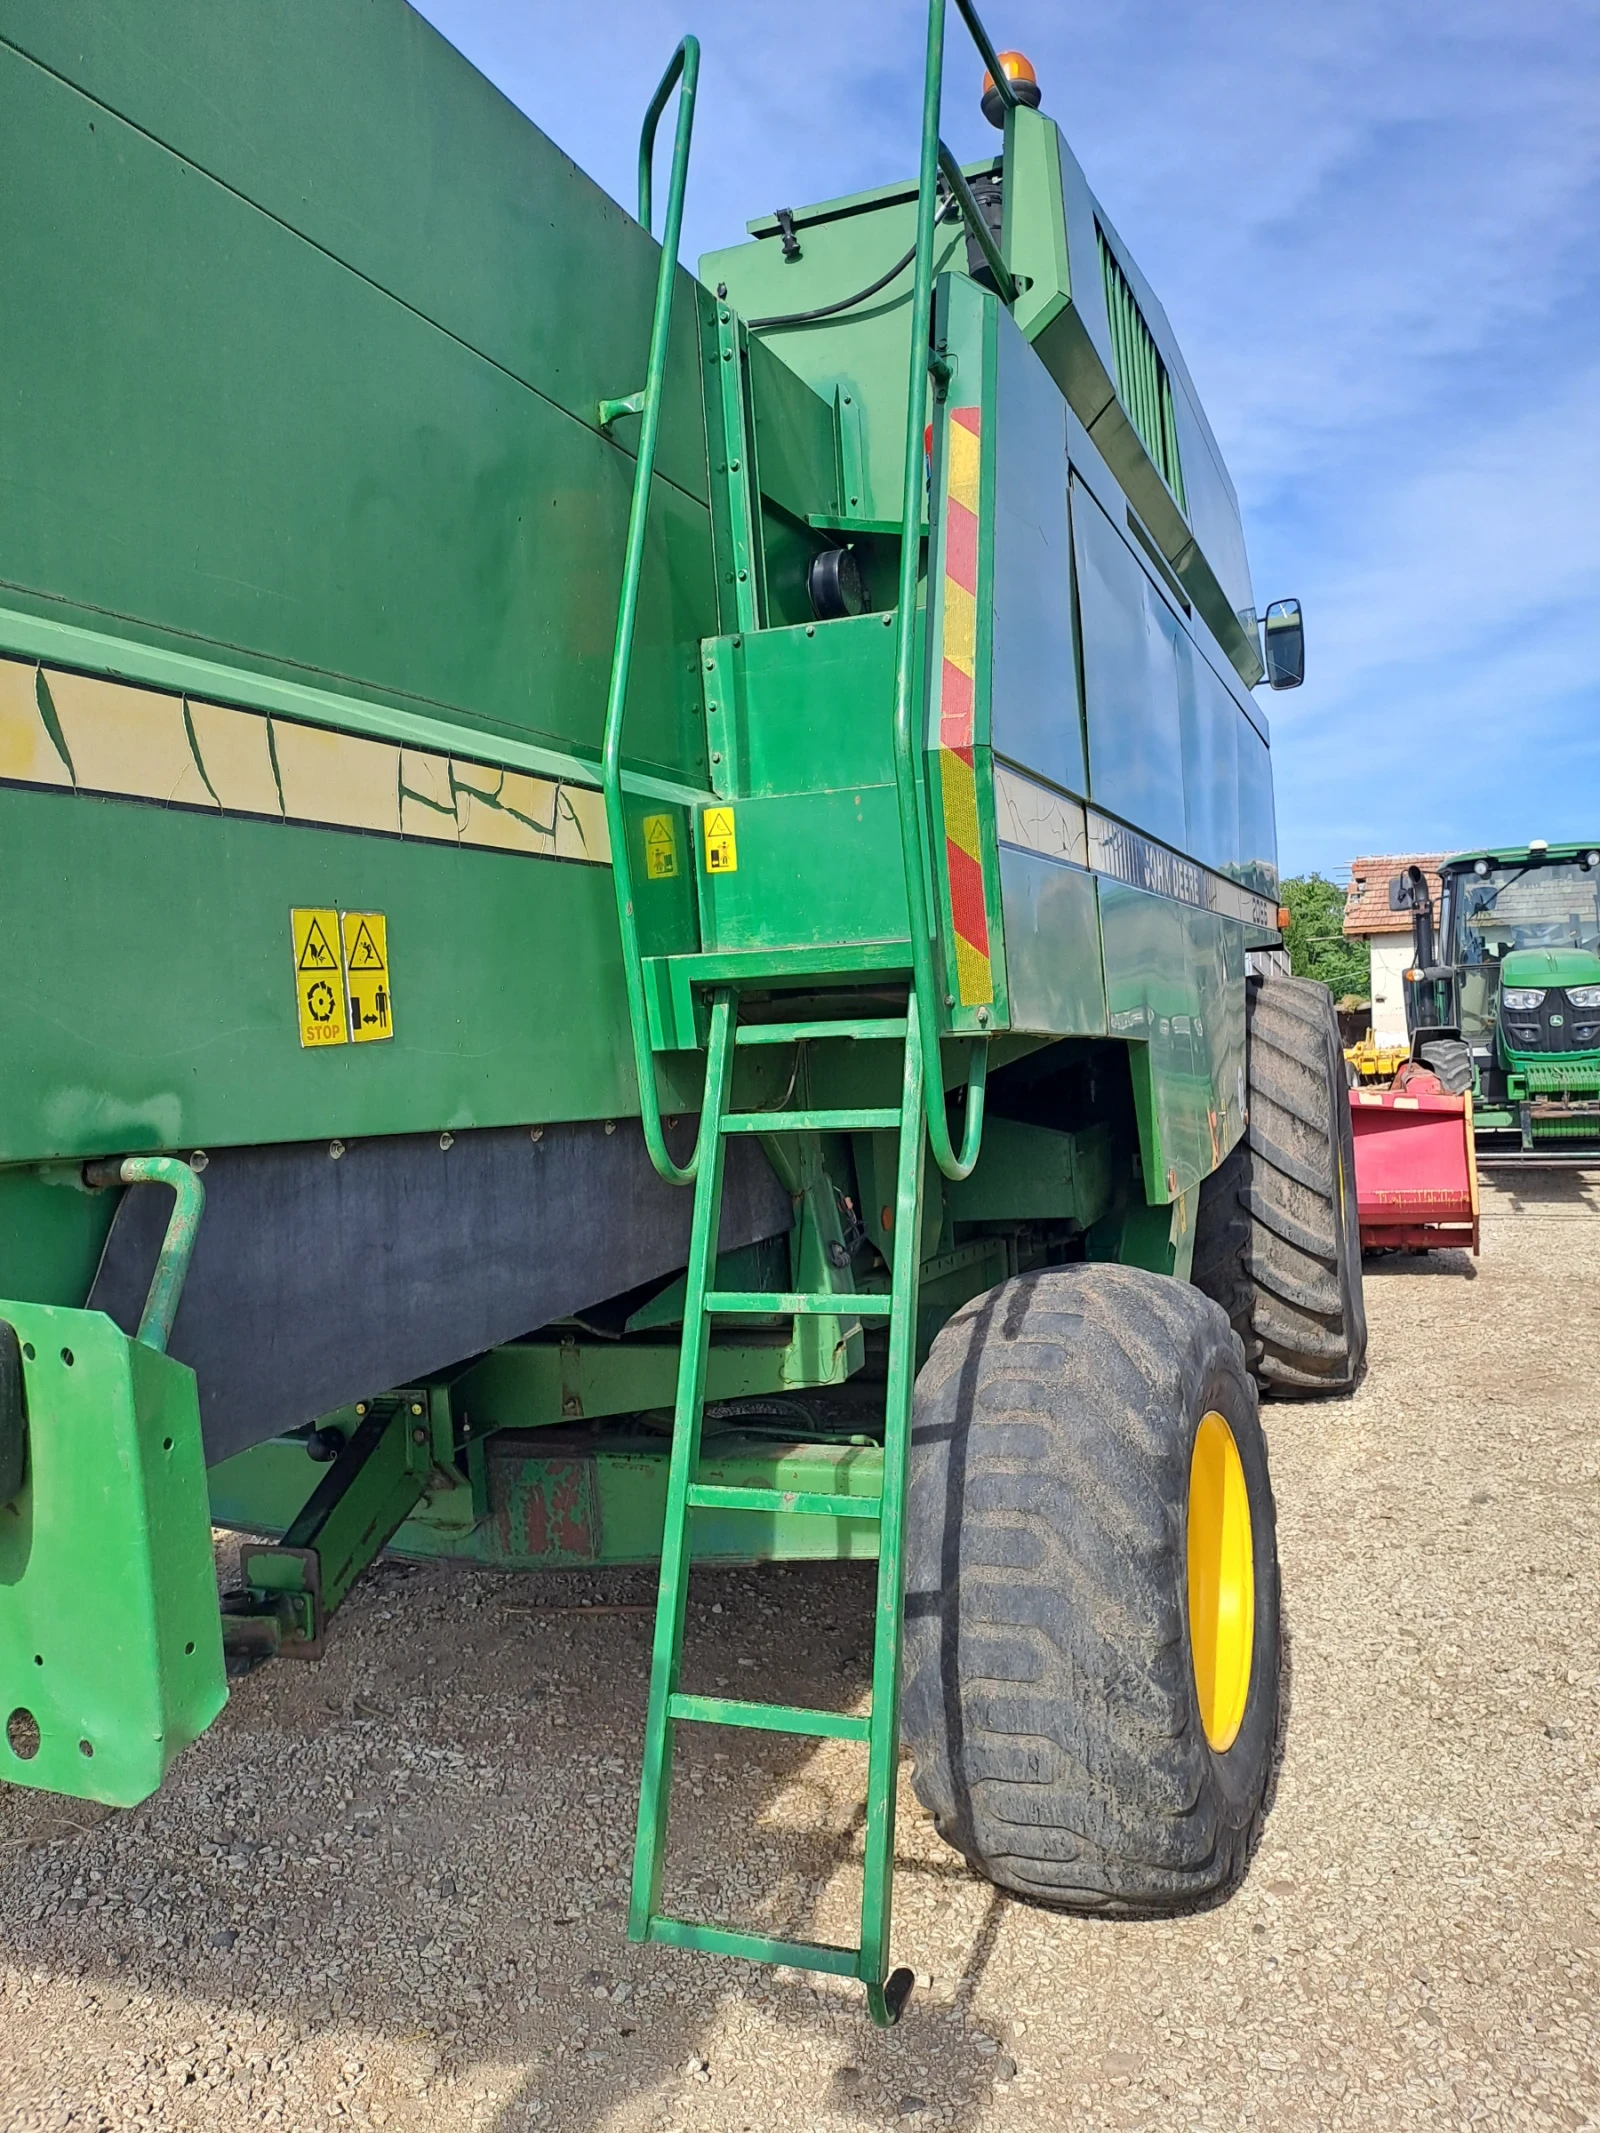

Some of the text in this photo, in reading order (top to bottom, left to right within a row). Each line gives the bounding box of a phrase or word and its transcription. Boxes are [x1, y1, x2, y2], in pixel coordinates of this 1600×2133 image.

[1144, 844, 1199, 905] JOHN DEERE
[306, 1024, 340, 1041] STOP
